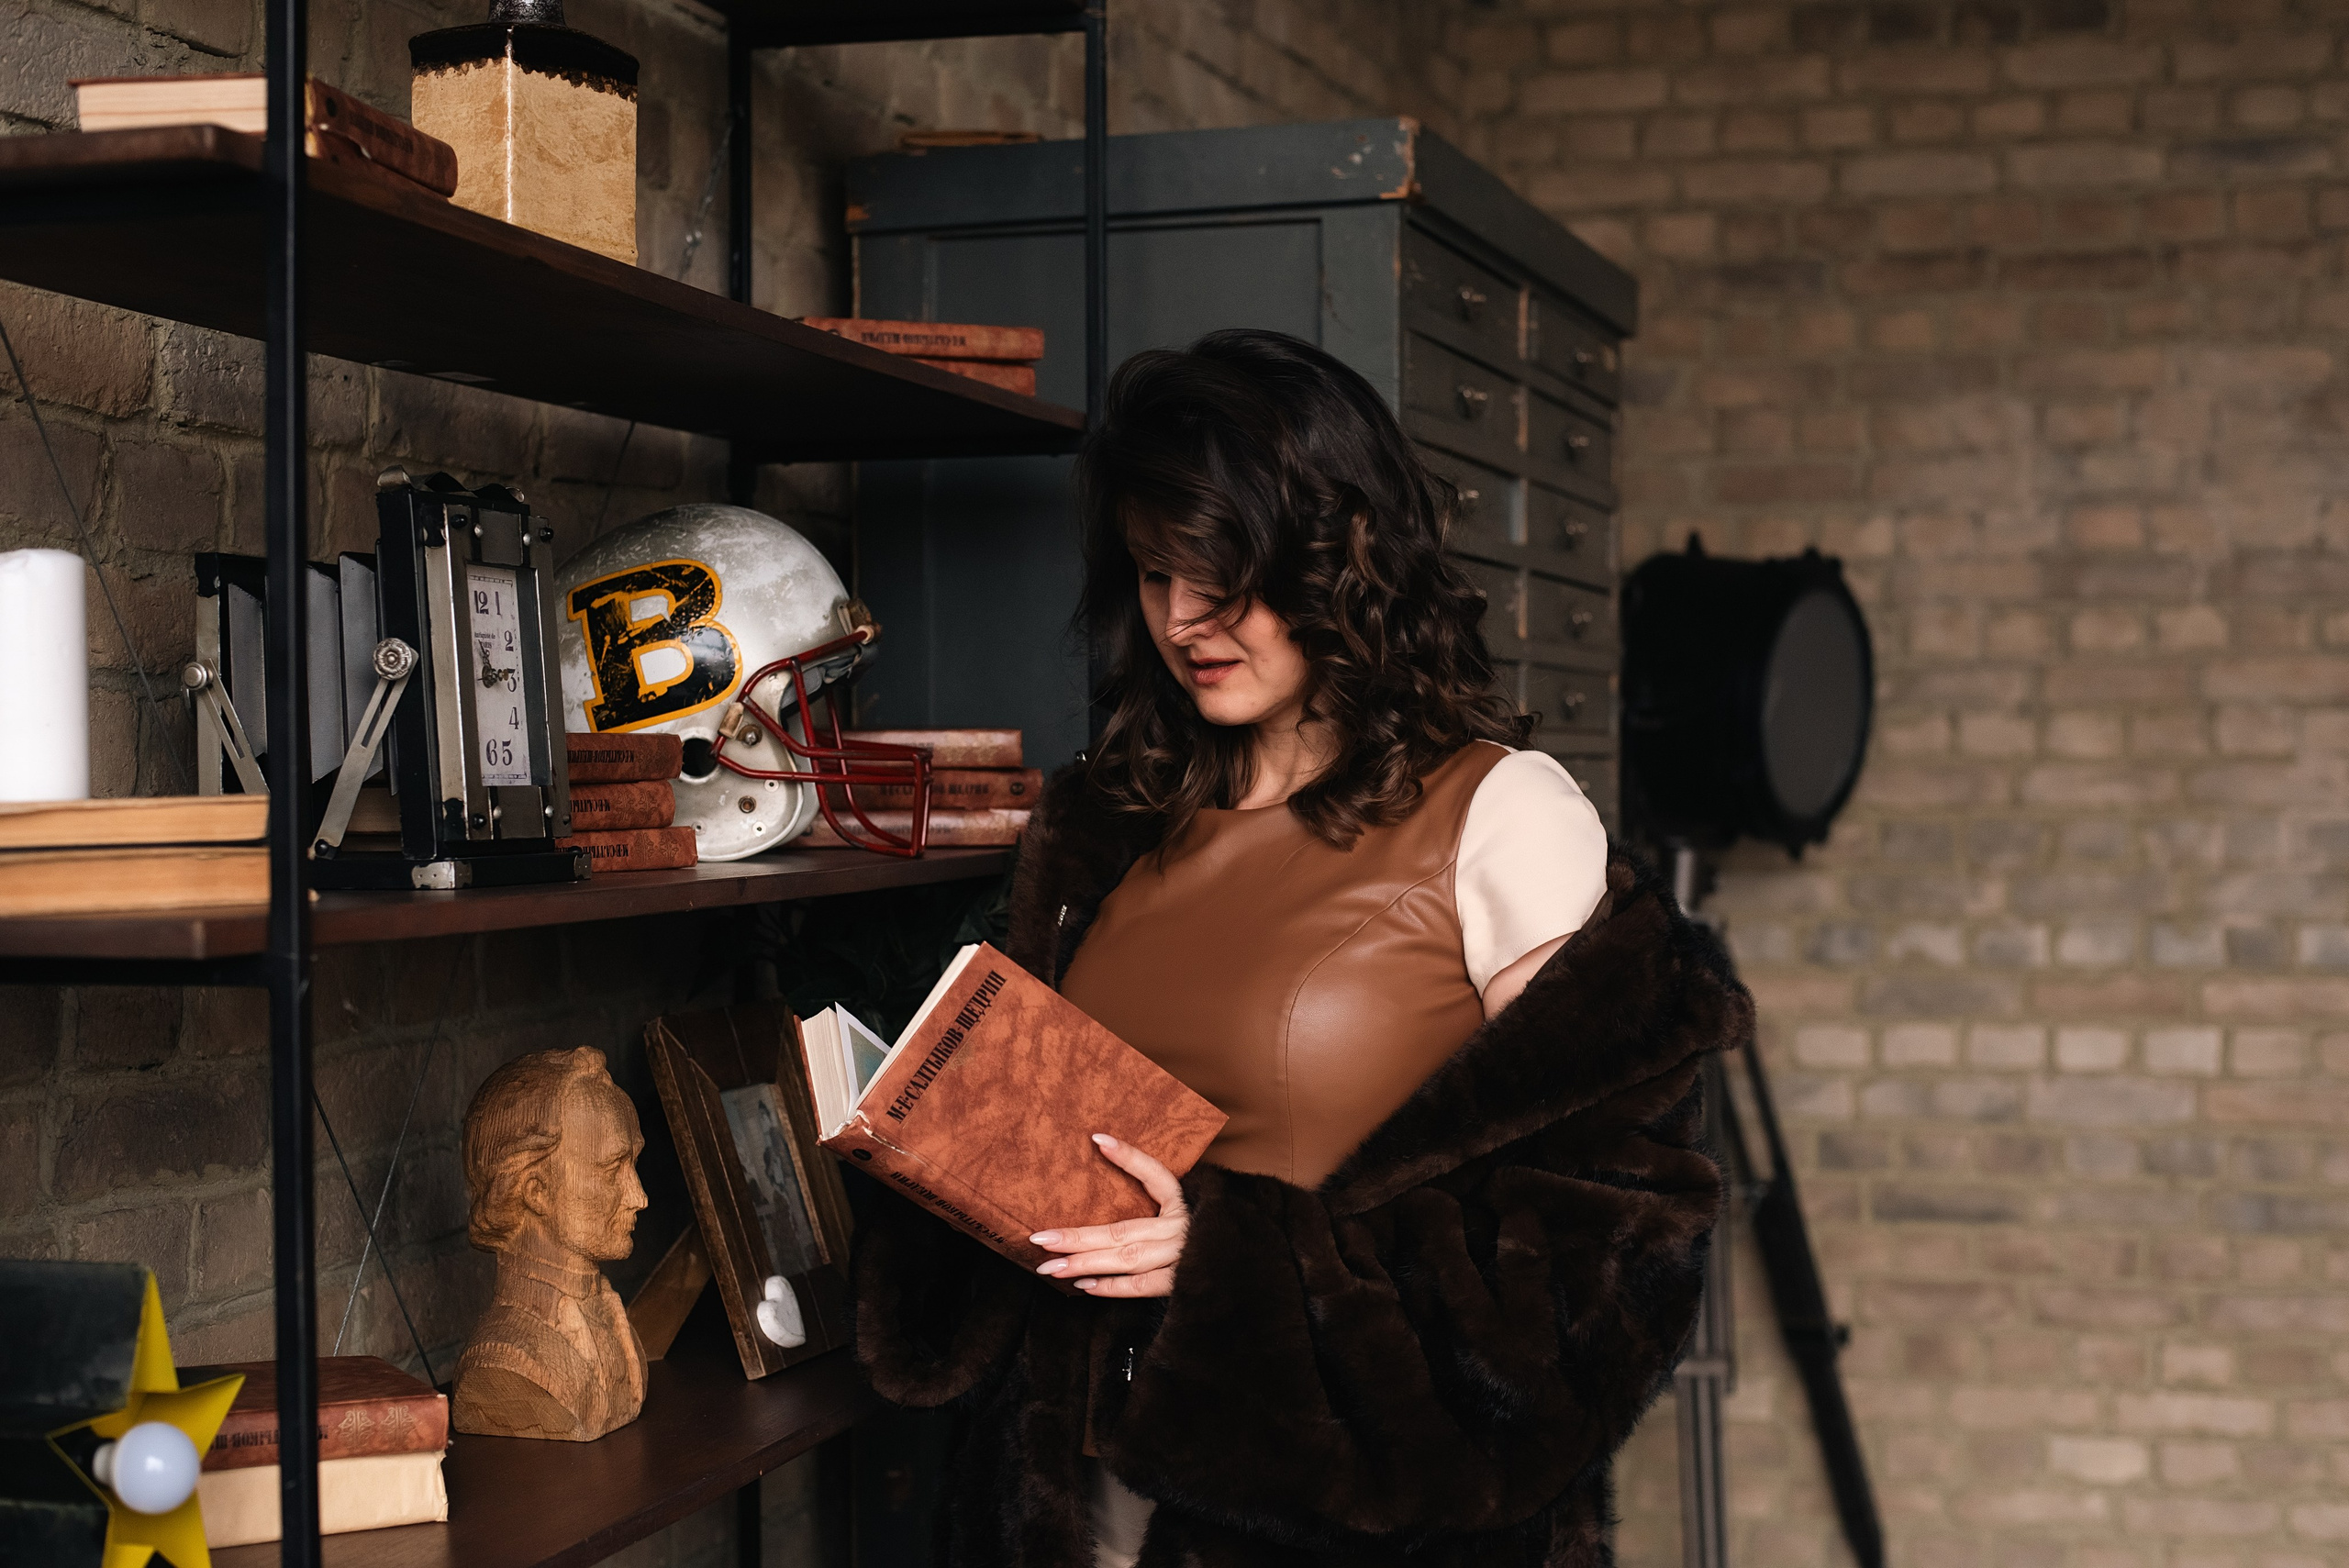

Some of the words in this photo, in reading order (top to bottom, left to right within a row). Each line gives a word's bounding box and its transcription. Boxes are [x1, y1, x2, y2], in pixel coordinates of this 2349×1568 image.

[473, 590, 489, 615] 12
[495, 591, 501, 616] 1
[504, 629, 514, 652] 2
[566, 559, 744, 733] B
[506, 667, 518, 693] 3
[508, 706, 519, 730] 4
[485, 738, 498, 767] 6
[501, 738, 513, 767] 5
